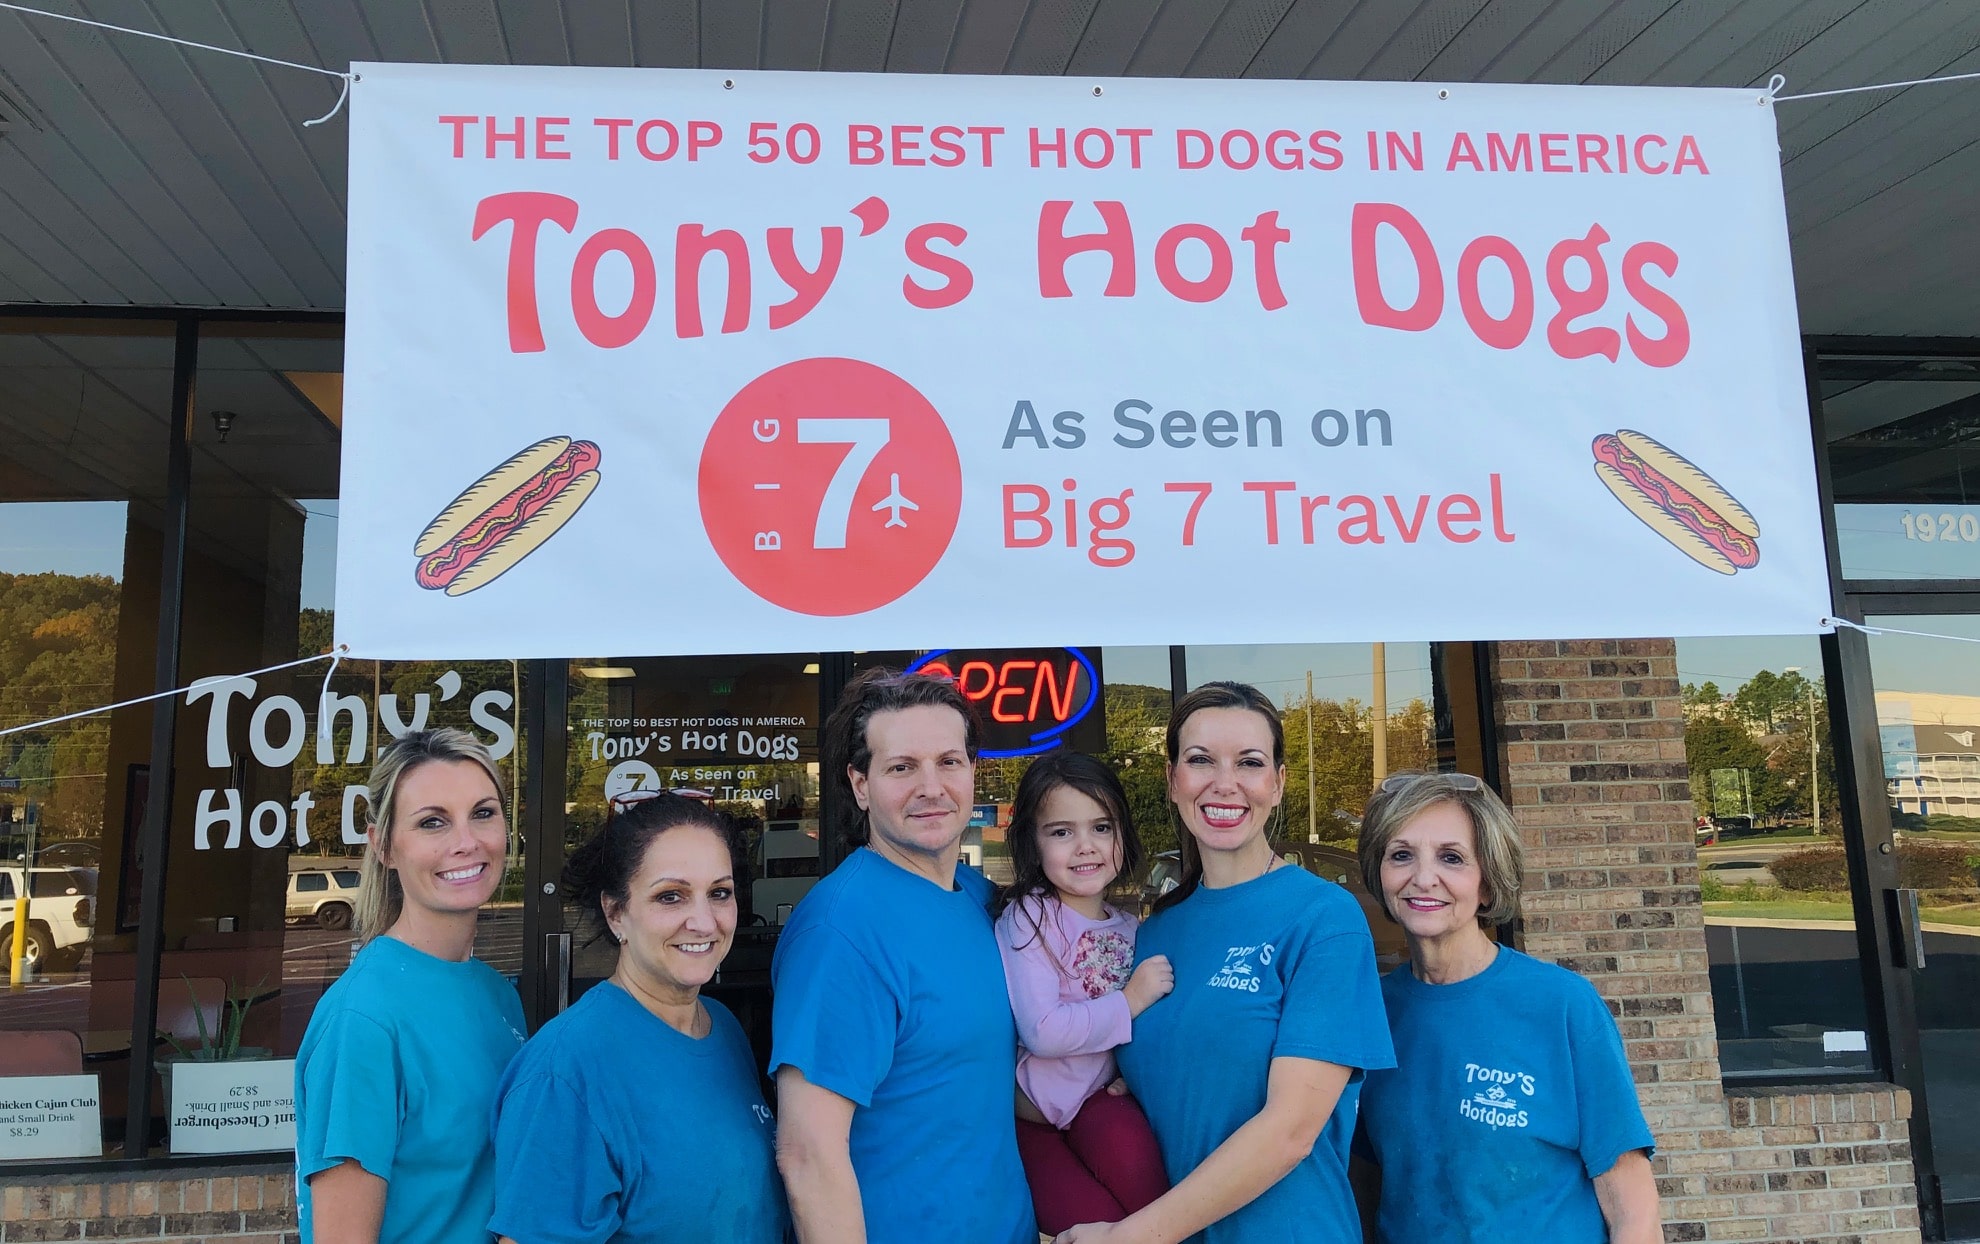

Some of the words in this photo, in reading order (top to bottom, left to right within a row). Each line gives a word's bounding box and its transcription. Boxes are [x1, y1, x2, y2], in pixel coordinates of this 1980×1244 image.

[440, 115, 571, 160] THE
[593, 118, 723, 162] TOP
[748, 122, 822, 164] 50
[848, 124, 1005, 168] BEST
[1029, 127, 1153, 169] HOT
[1176, 129, 1343, 171] DOGS
[1367, 131, 1424, 171] IN
[1446, 133, 1709, 175] AMERICA
[472, 191, 974, 353] Tony's
[1037, 200, 1291, 311] Hot
[1351, 203, 1690, 368] Dogs
[1001, 400, 1086, 450] As
[1112, 399, 1283, 449] Seen
[1311, 407, 1393, 447] on
[754, 418, 781, 551] BIG
[797, 418, 891, 550] 7
[1002, 478, 1135, 567] Big
[1164, 482, 1212, 546] 7
[1243, 473, 1515, 546] Travel
[1901, 512, 1979, 542] 1920
[582, 718, 604, 728] THE
[608, 718, 630, 728] TOP
[633, 718, 647, 727] 50
[650, 718, 679, 727] BEST
[682, 718, 705, 727] HOT
[708, 717, 739, 727] DOGS
[742, 717, 754, 726] IN
[756, 716, 806, 726] AMERICA
[587, 731, 672, 761] Tony's
[681, 730, 728, 752] Hot
[737, 730, 799, 761] Dogs
[670, 768, 688, 781] As
[694, 768, 732, 780] Seen
[737, 769, 756, 780] on
[721, 784, 781, 801] Travel
[194, 788, 315, 850] Hot
[229, 1085, 259, 1097] $8.29
[35, 1099, 68, 1111] Cajun
[70, 1098, 97, 1108] Club
[220, 1100, 250, 1112] Small
[253, 1099, 271, 1111] and
[274, 1098, 296, 1109] ries
[18, 1113, 45, 1124] Small
[48, 1112, 76, 1123] Drink
[174, 1114, 270, 1130] Cheeseburger
[10, 1126, 39, 1137] $8.29
